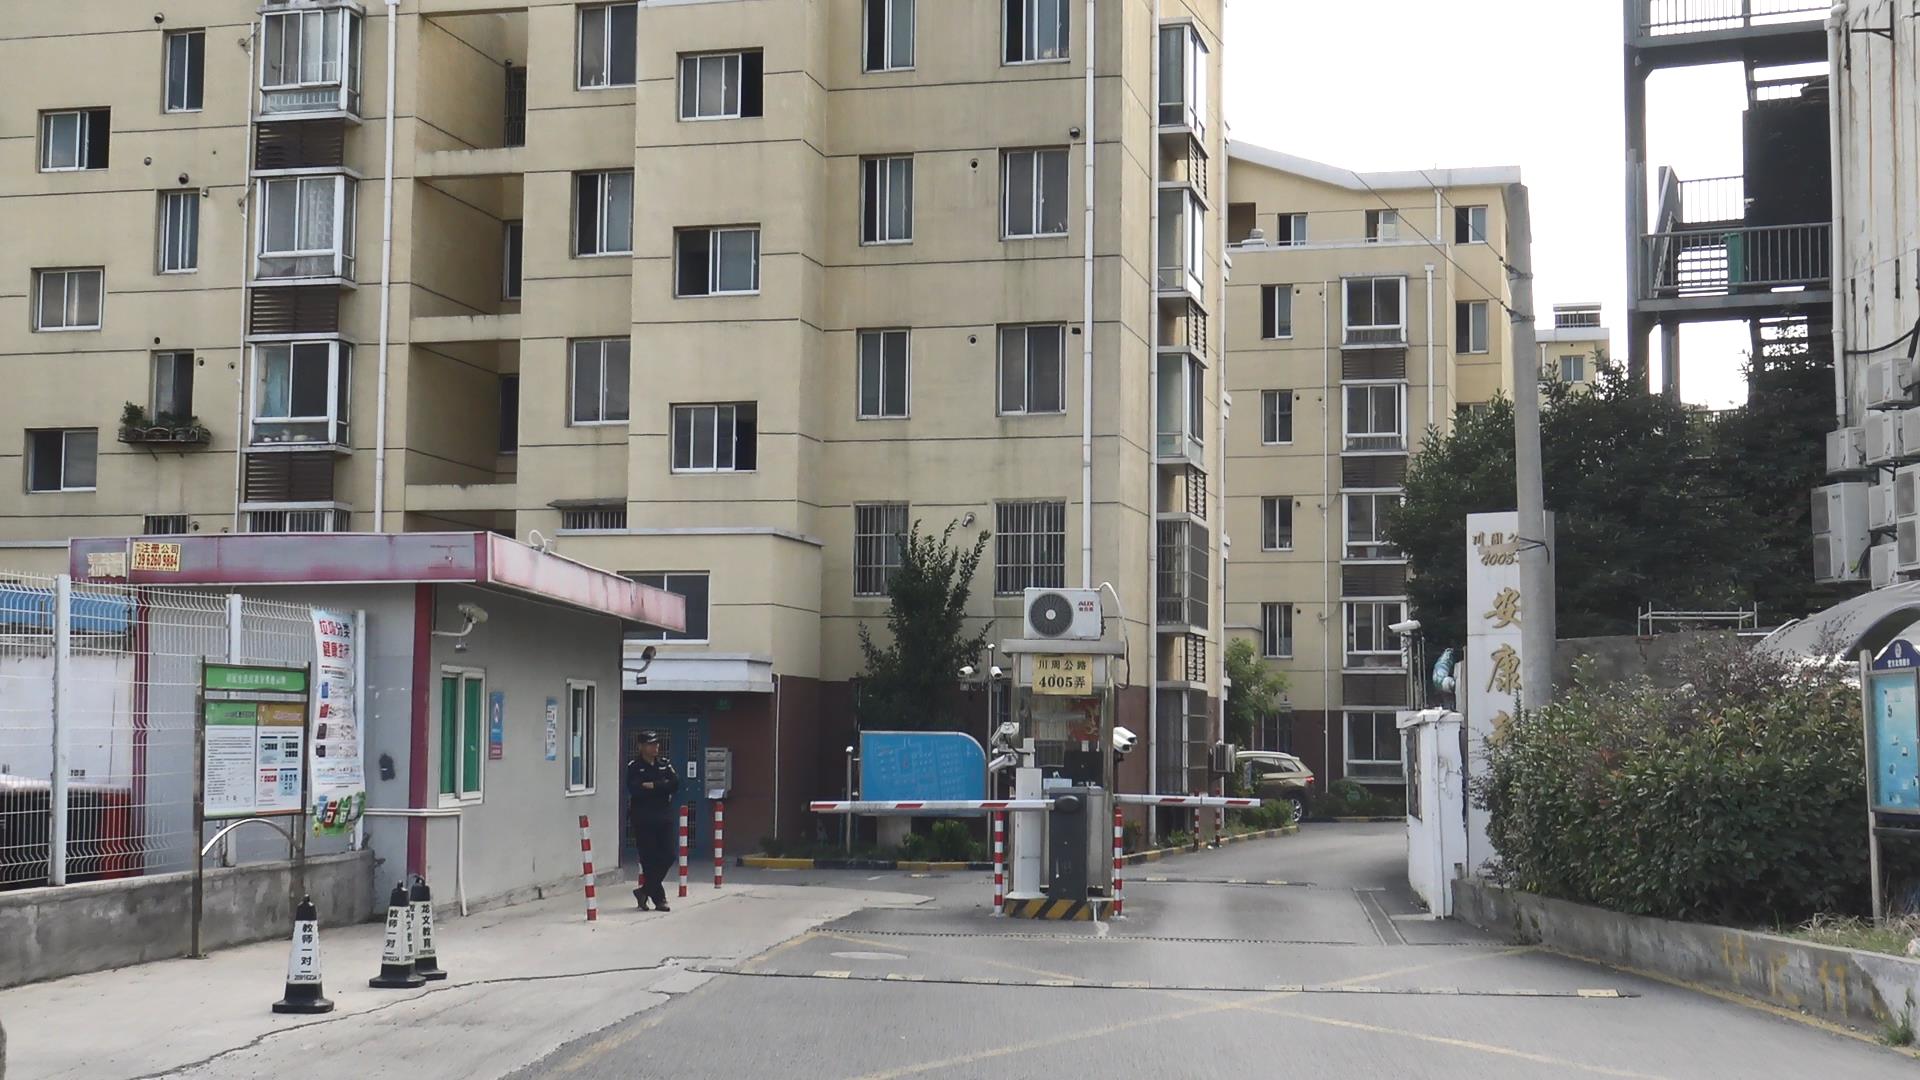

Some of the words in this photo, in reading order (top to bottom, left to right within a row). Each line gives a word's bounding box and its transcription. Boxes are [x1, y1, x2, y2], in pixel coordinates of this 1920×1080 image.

[1480, 552, 1519, 566] 4005
[319, 620, 350, 639] 垃圾分类
[1038, 659, 1087, 671] 川周公路
[1038, 675, 1086, 689] 4005弄
[384, 908, 400, 955] 教师一对一
[421, 903, 432, 948] 龙文教育
[300, 923, 313, 973] 教师一对一
